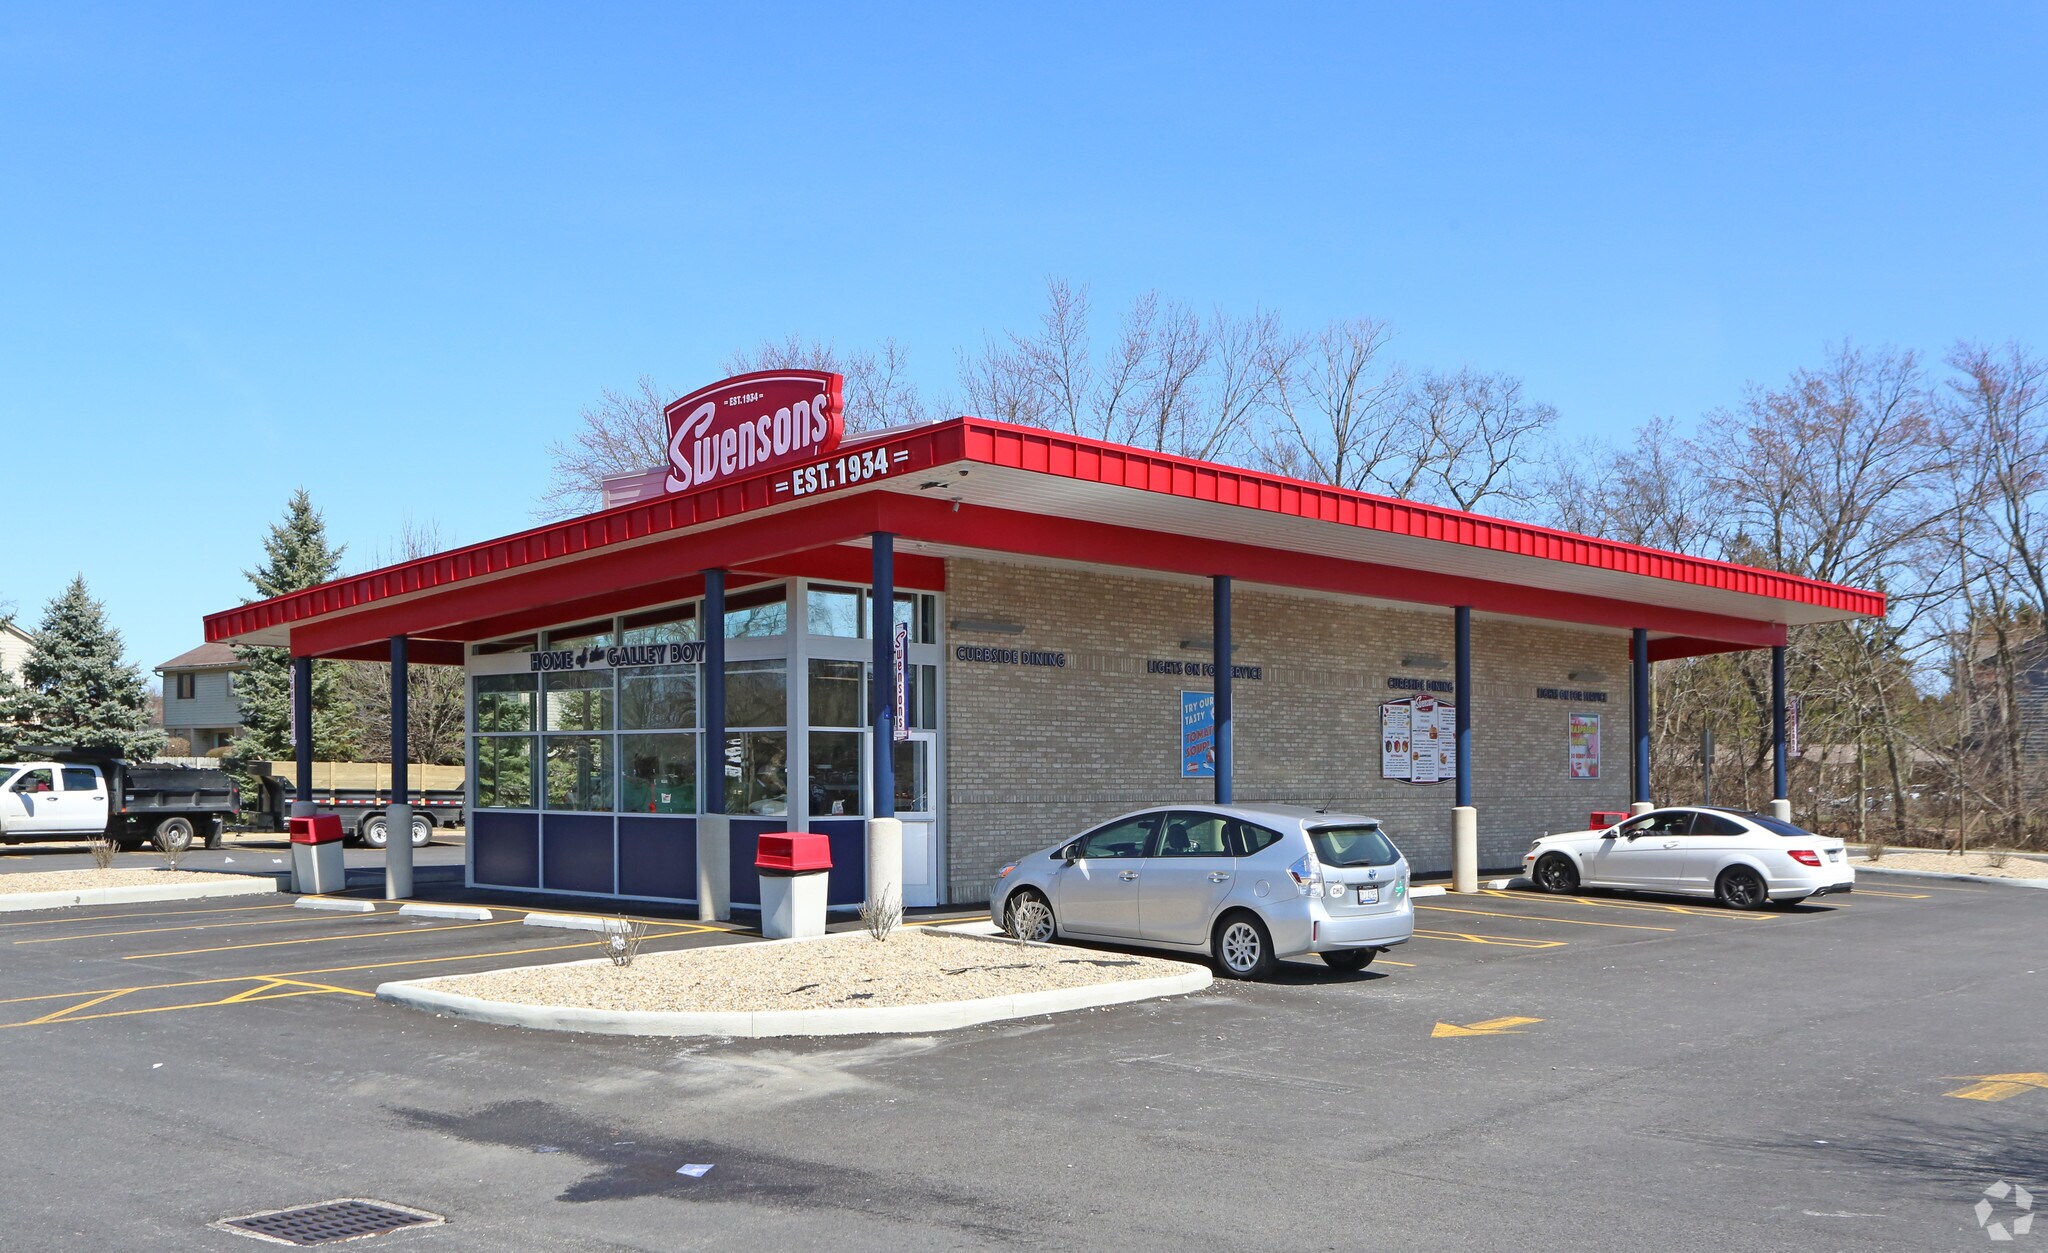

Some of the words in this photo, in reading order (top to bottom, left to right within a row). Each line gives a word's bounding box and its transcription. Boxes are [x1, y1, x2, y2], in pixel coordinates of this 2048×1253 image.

[665, 394, 827, 494] Swensons
[530, 652, 573, 671] HOME
[576, 647, 588, 668] of
[607, 644, 667, 666] GALLEY
[670, 642, 706, 663] BOY
[956, 646, 1018, 664] CURBSIDE
[1021, 650, 1066, 667] DINING
[895, 630, 906, 729] Swensons
[1147, 660, 1183, 674] LIGHTS
[1185, 662, 1200, 675] ON
[1202, 663, 1215, 677] FO
[1231, 665, 1263, 680] ERVICE
[1426, 680, 1454, 693] DINING
[1184, 702, 1198, 714] TRY
[1199, 696, 1214, 709] OUR
[1184, 711, 1206, 726] TASTY
[1185, 725, 1214, 744] TOMAT
